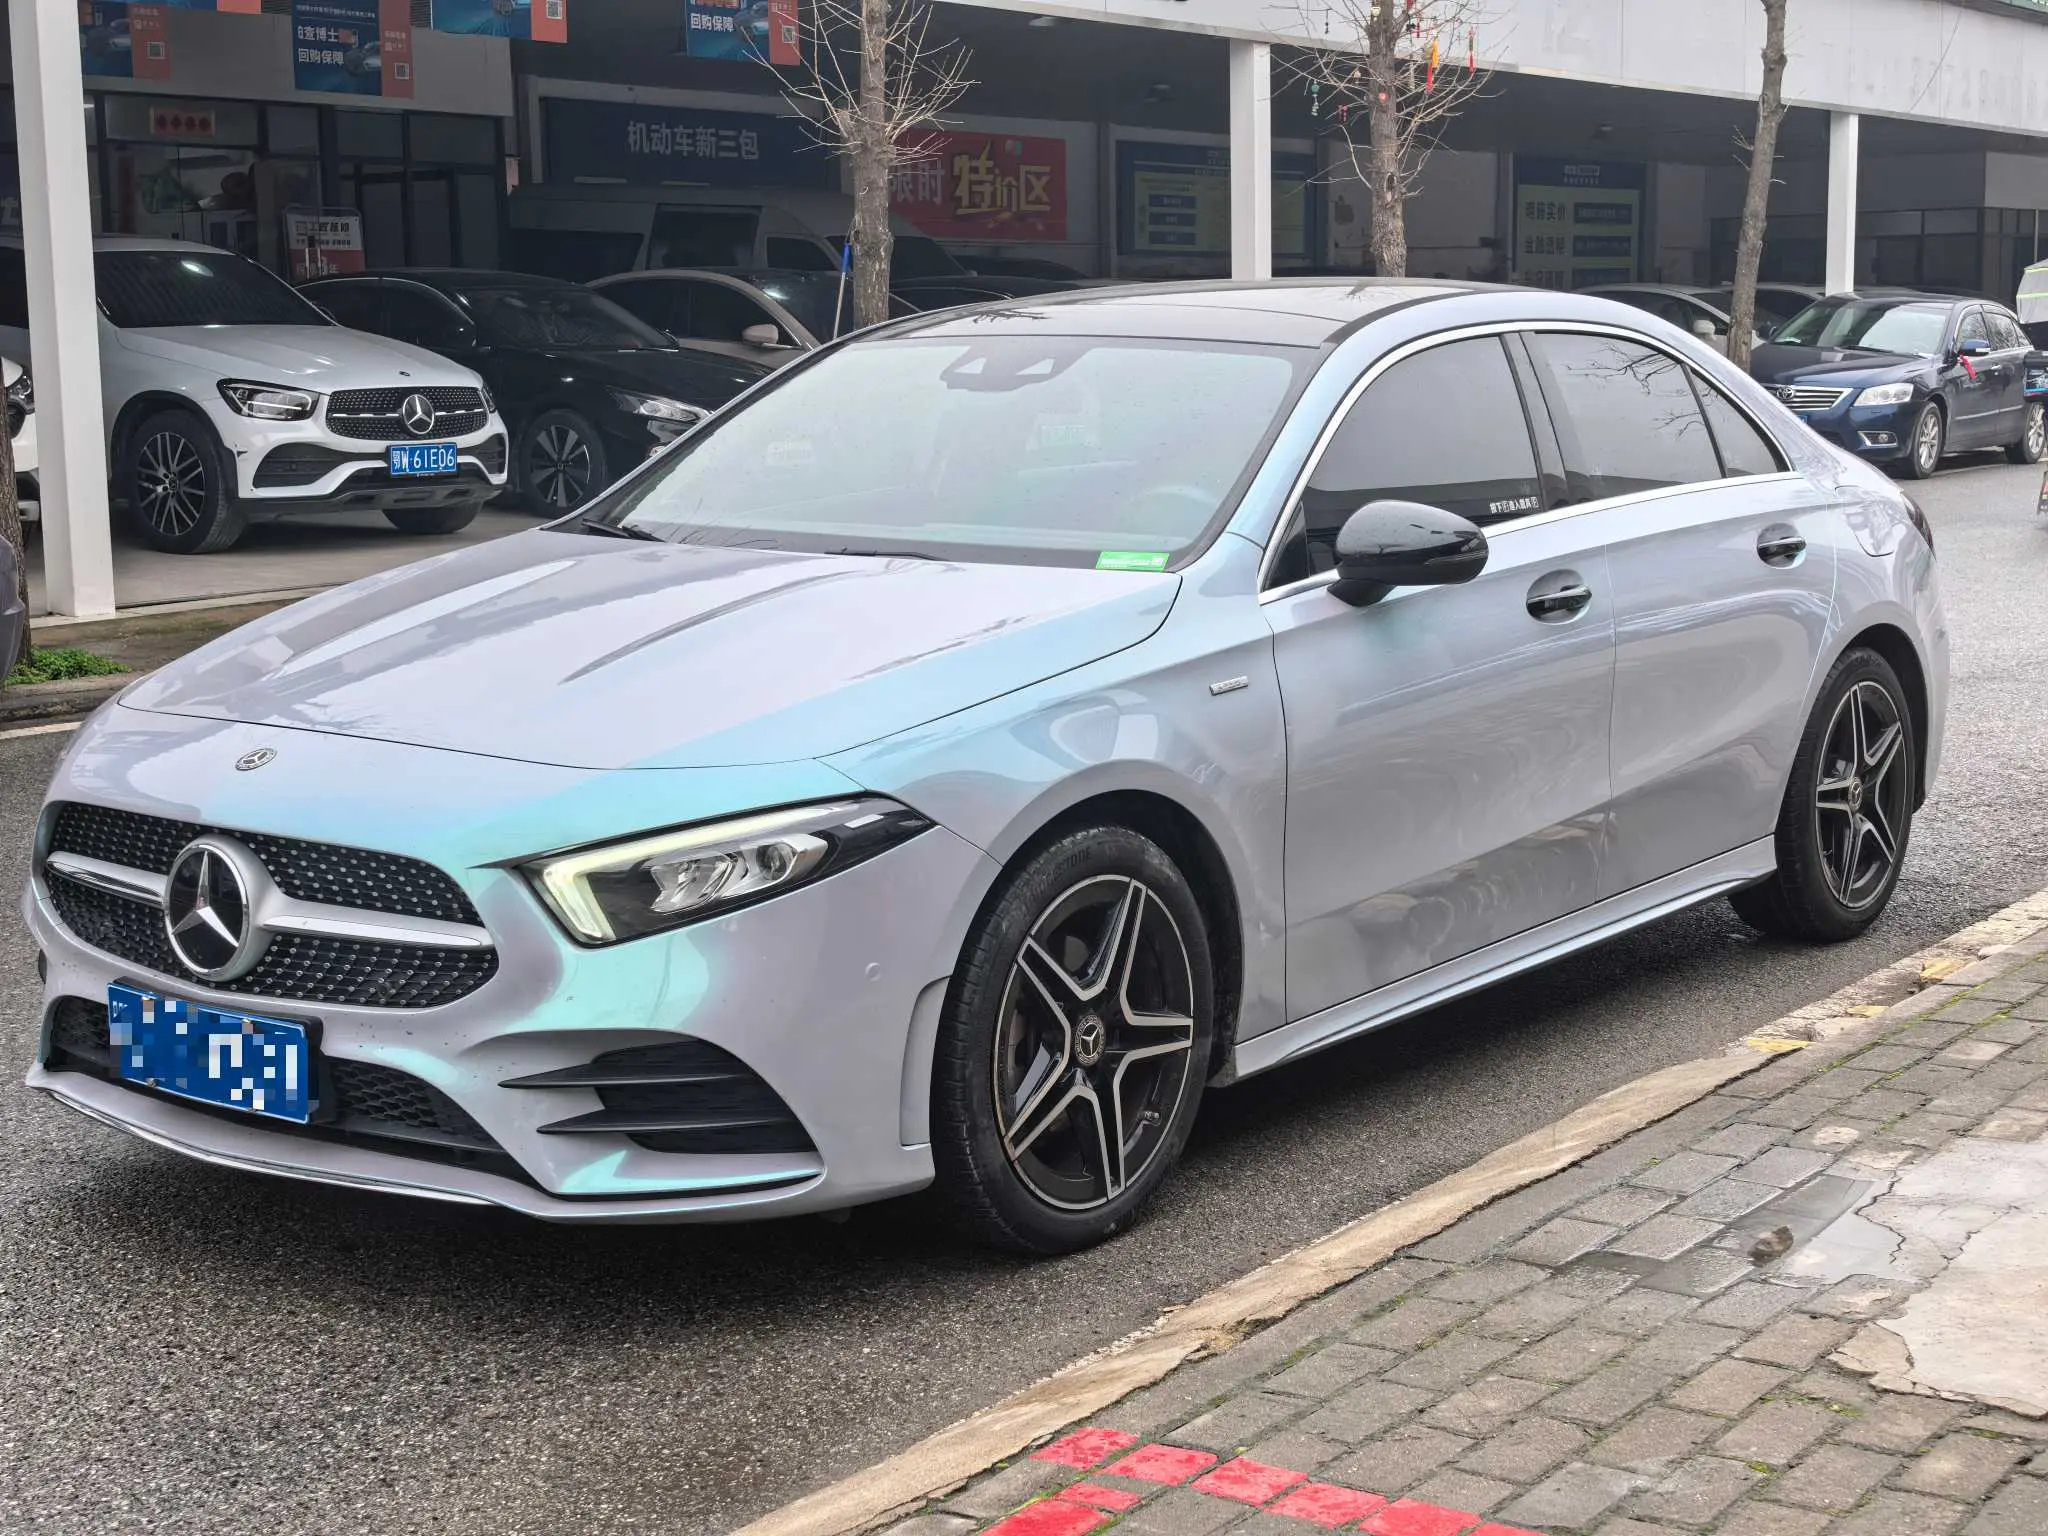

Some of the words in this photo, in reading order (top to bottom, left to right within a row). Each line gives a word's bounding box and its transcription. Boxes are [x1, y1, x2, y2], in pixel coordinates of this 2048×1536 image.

[690, 13, 735, 32] 回购保障
[298, 48, 345, 66] 回购保障
[627, 120, 760, 160] 机动车新三包
